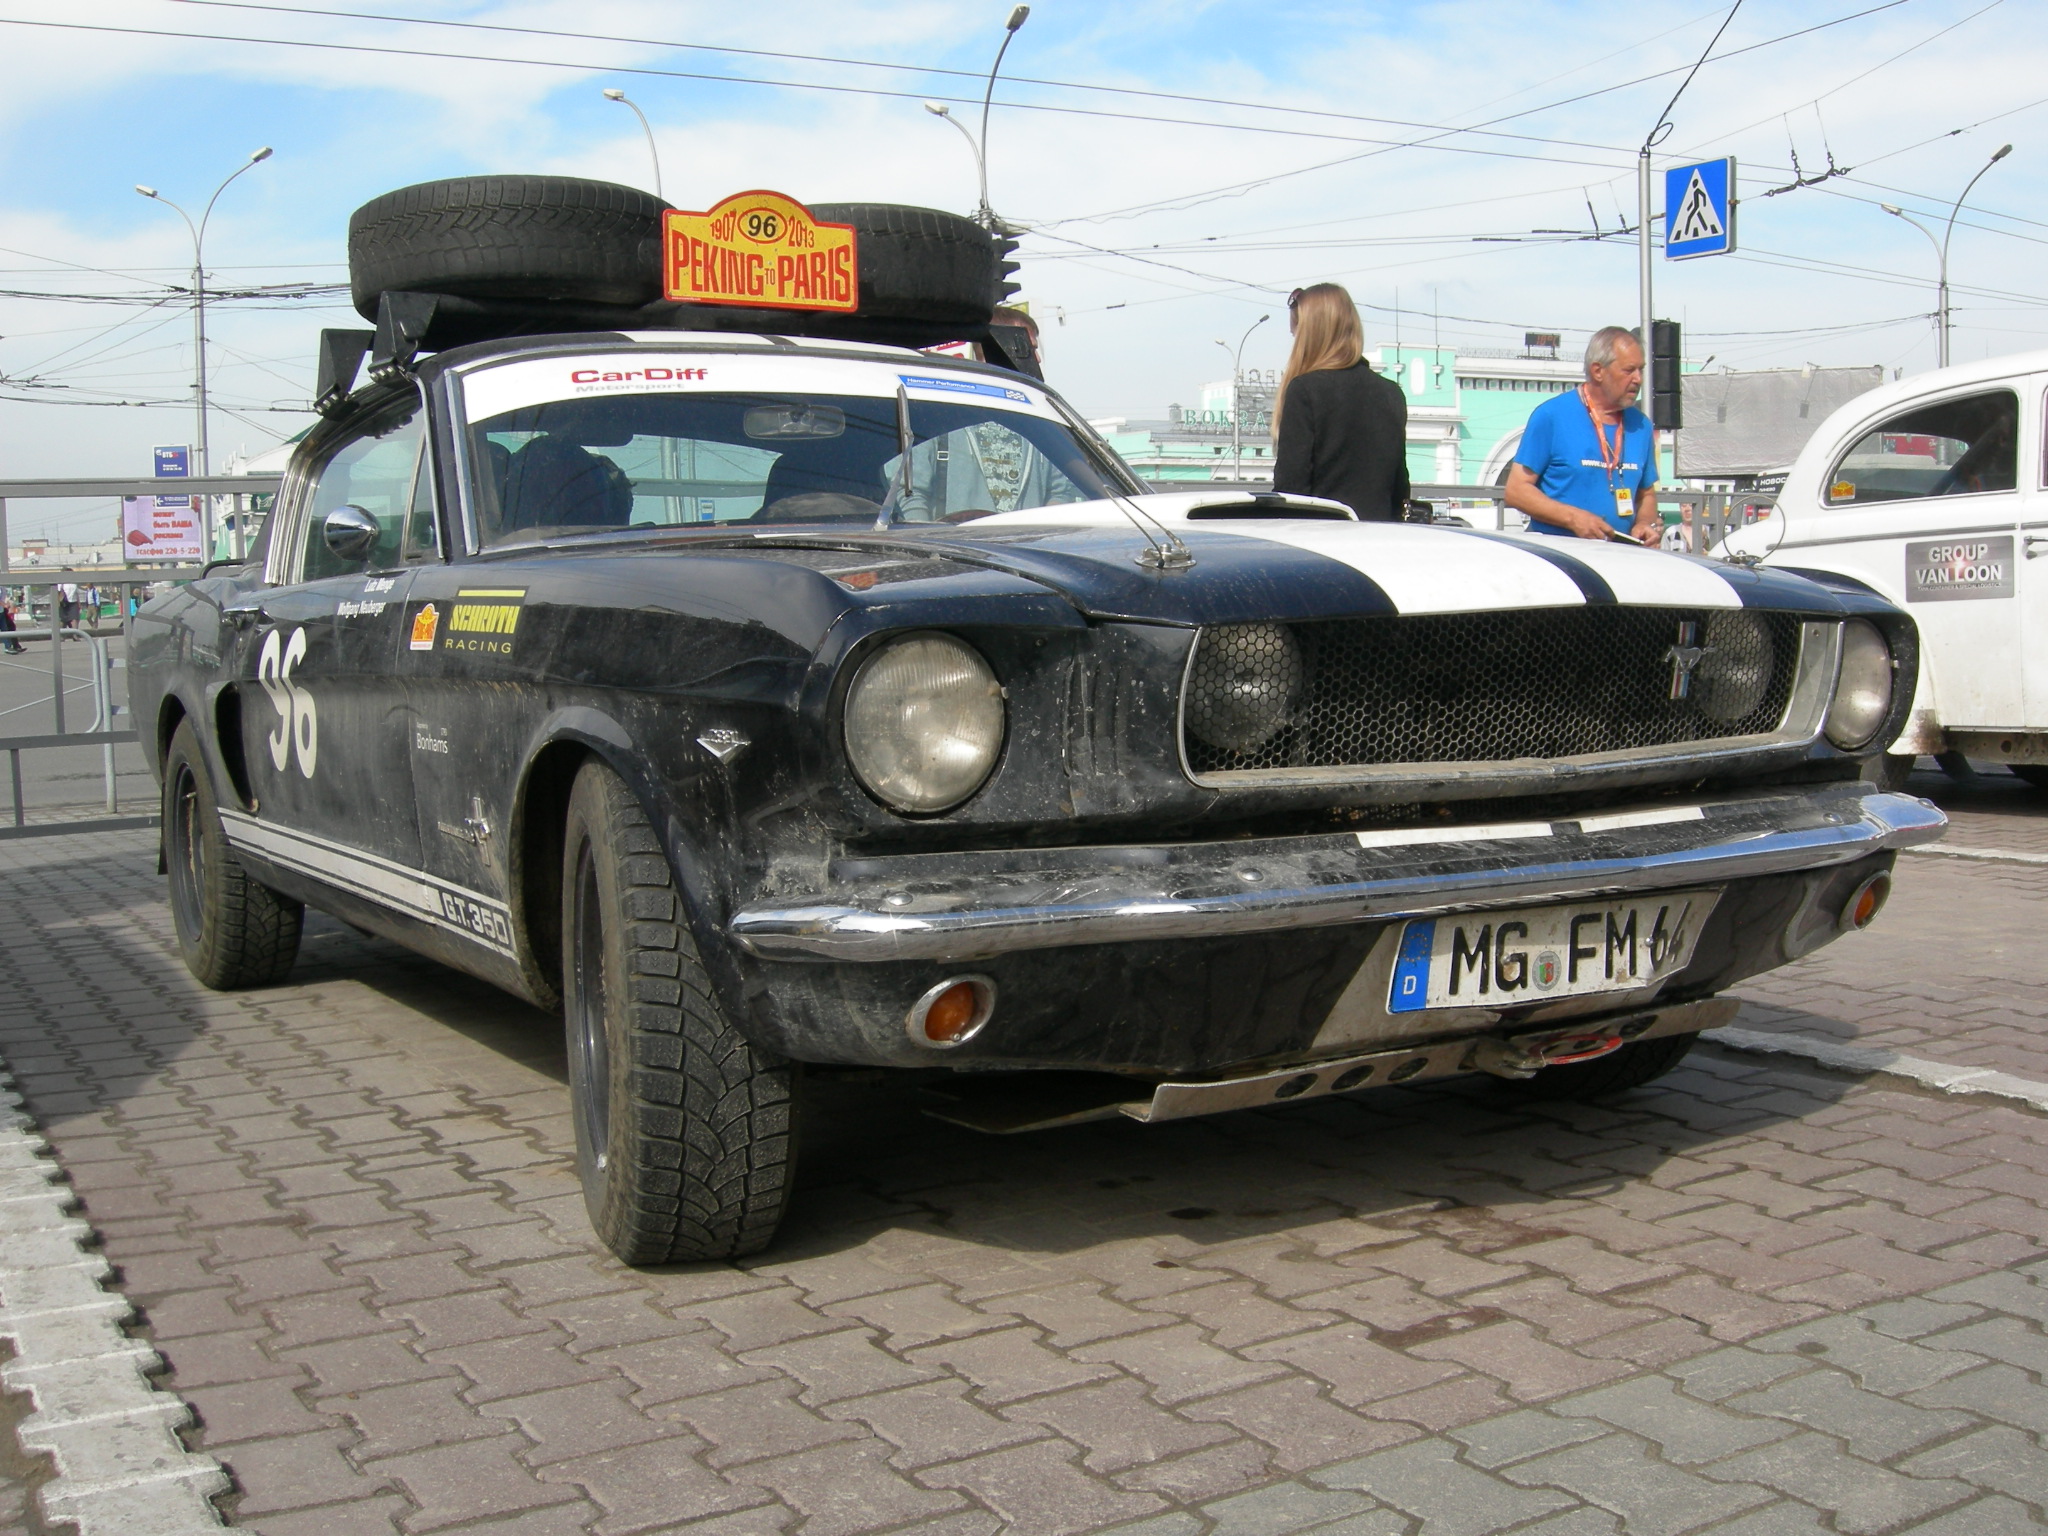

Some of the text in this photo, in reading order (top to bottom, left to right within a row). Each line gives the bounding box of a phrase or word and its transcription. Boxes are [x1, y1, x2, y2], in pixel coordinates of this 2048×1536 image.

[710, 210, 815, 248] 1907 96 2013
[672, 230, 851, 302] PEKING TO PARIS
[571, 368, 708, 383] CarDiff
[935, 381, 976, 389] Performance
[576, 383, 685, 392] Motorsport
[1184, 409, 1267, 428] ВОКЗА
[1760, 477, 1788, 486] НОВОС
[1928, 543, 1988, 563] GROUP
[1915, 564, 2002, 584] VAN LOON
[337, 602, 360, 619] Wolfgang
[450, 605, 520, 634] SCHROTH
[445, 638, 512, 654] RACING
[258, 627, 317, 779] 96
[417, 733, 448, 753] Bonhams
[442, 892, 509, 945] G.T.350
[1449, 921, 1529, 996] MG
[1567, 908, 1638, 984] FM
[1649, 900, 1691, 972] 64
[1402, 975, 1417, 996] D
